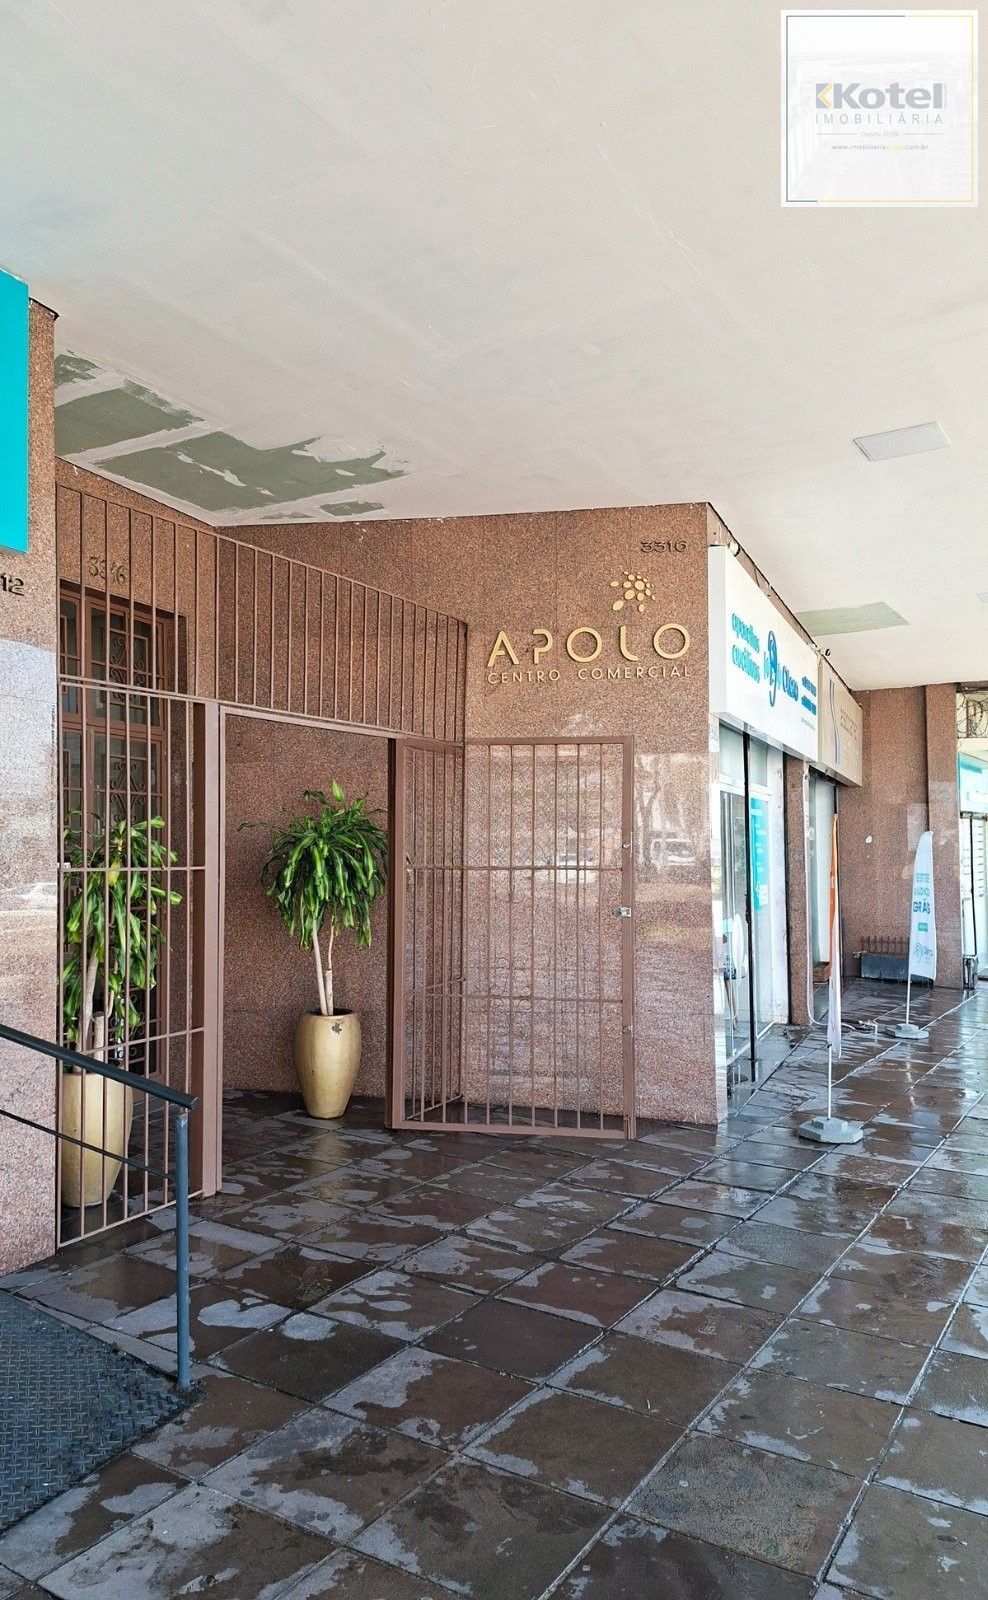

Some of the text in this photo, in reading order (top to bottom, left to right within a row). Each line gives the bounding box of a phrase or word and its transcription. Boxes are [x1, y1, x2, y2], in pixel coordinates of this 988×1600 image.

[639, 539, 688, 554] 3316
[487, 622, 691, 668] APOLO
[487, 665, 692, 685] CENTRO COMERCIAL
